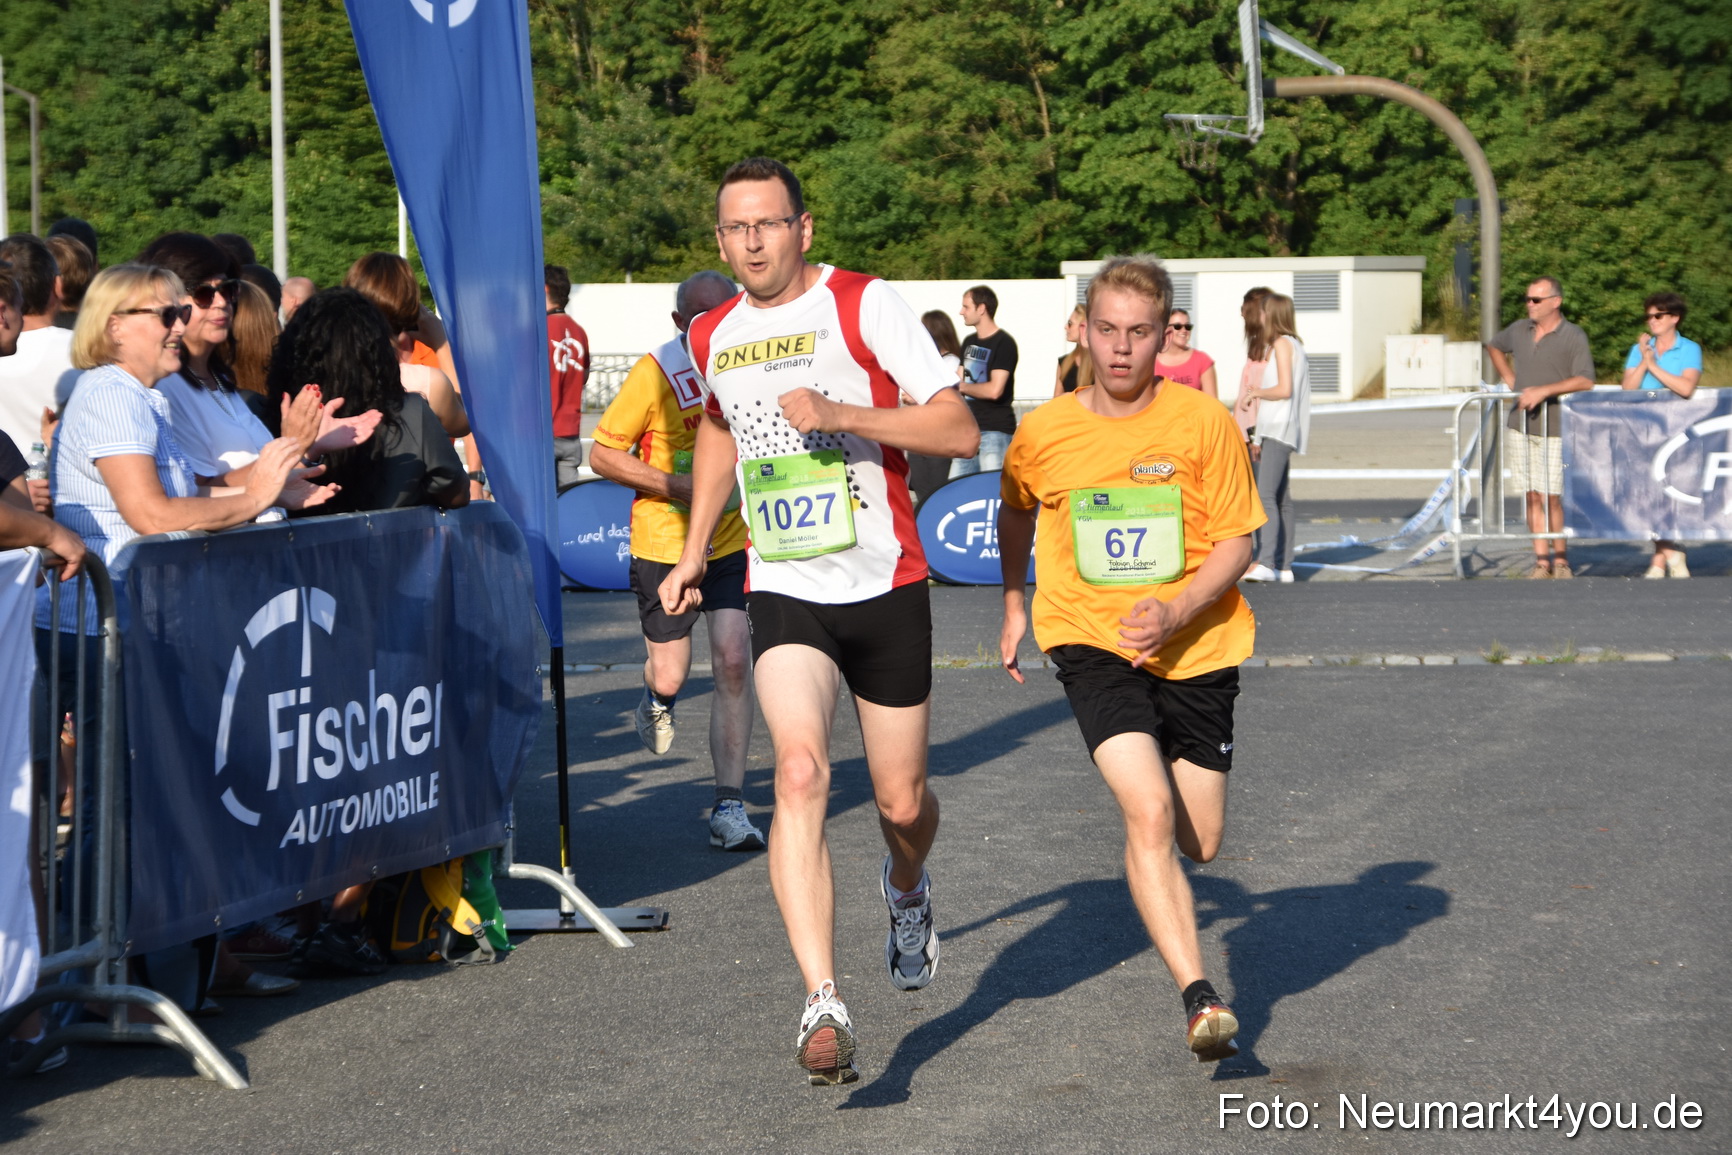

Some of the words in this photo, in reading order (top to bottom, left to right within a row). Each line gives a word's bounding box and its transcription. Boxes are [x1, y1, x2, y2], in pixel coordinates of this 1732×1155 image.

[716, 336, 806, 370] ONLINE
[764, 357, 814, 372] Germany
[1134, 464, 1160, 476] plank
[757, 492, 836, 532] 1027
[577, 526, 605, 544] und
[607, 523, 631, 538] das
[779, 537, 797, 545] Daniel
[1105, 527, 1147, 559] 67
[266, 669, 443, 792] Fischer
[279, 771, 440, 849] AUTOMOBILE
